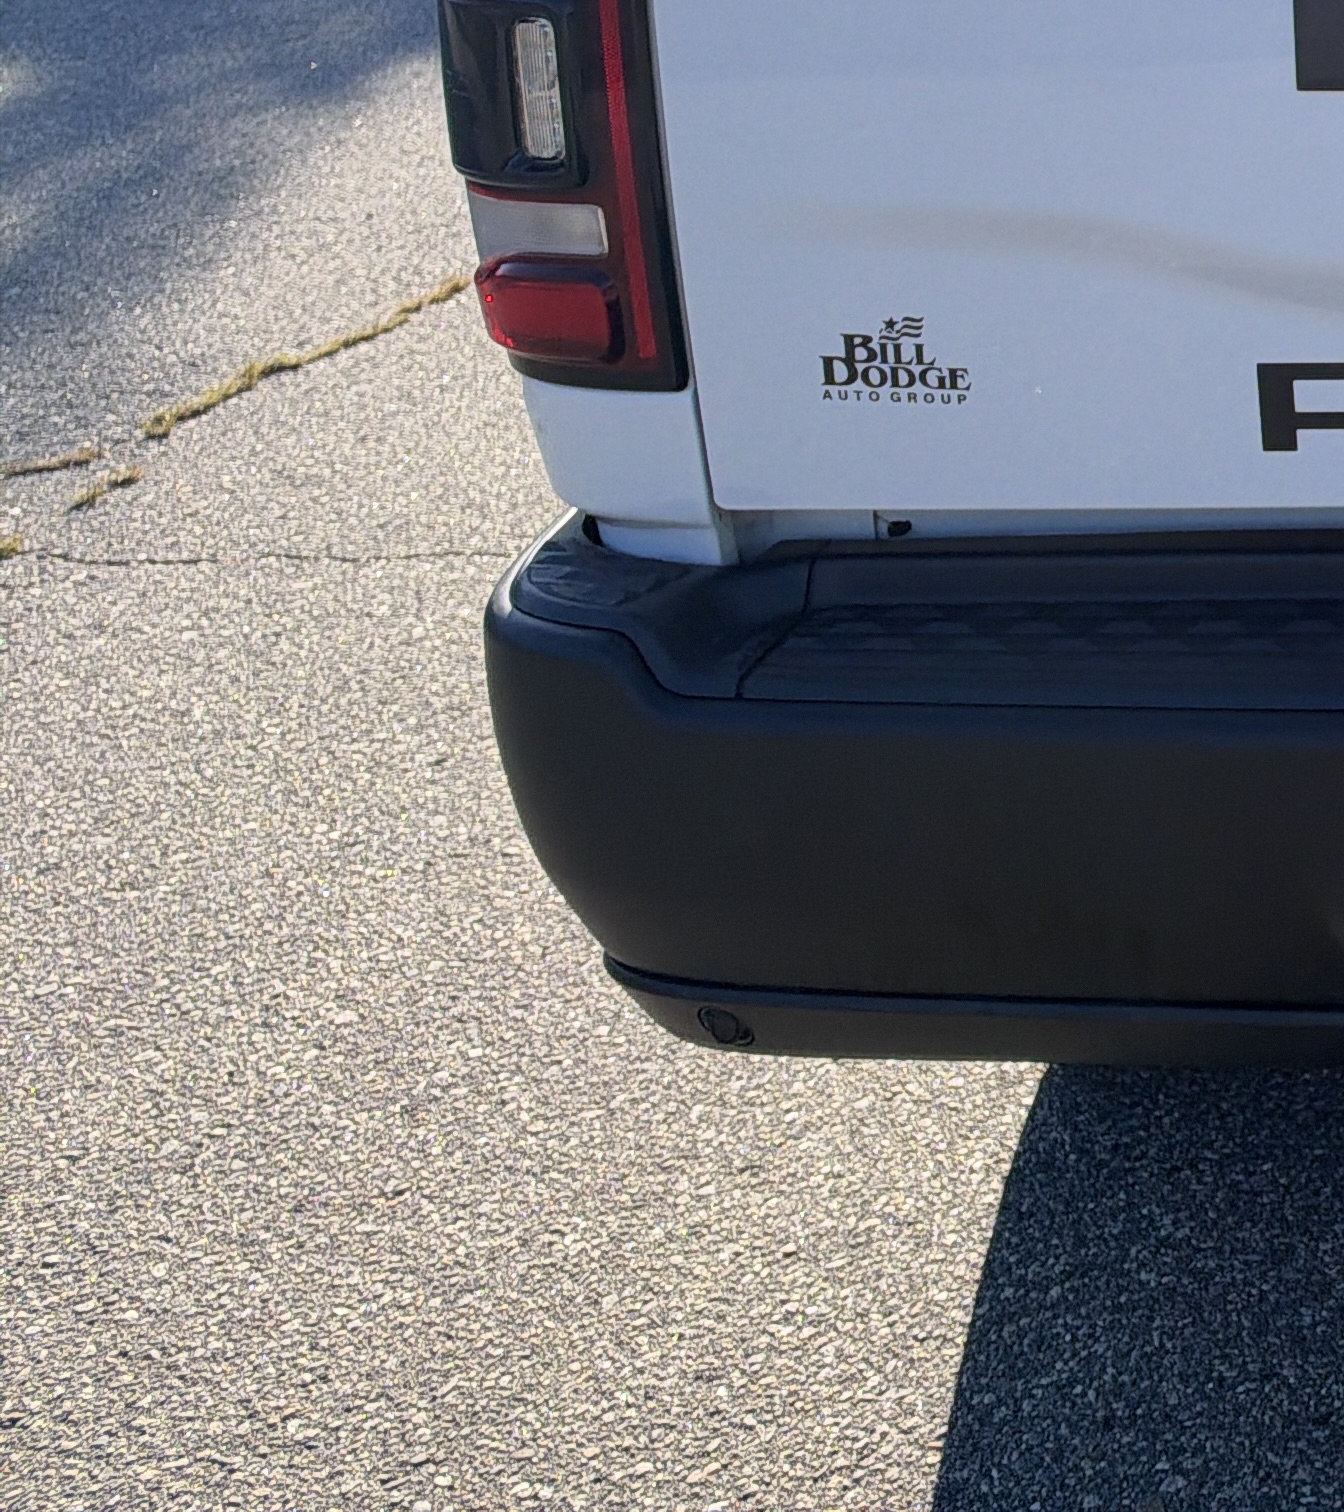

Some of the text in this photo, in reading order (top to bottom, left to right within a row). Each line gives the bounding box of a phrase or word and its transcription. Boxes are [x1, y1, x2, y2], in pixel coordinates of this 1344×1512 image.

[840, 333, 937, 366] BILL
[819, 355, 972, 391] DODGE
[822, 389, 968, 405] AUTO GROUP
